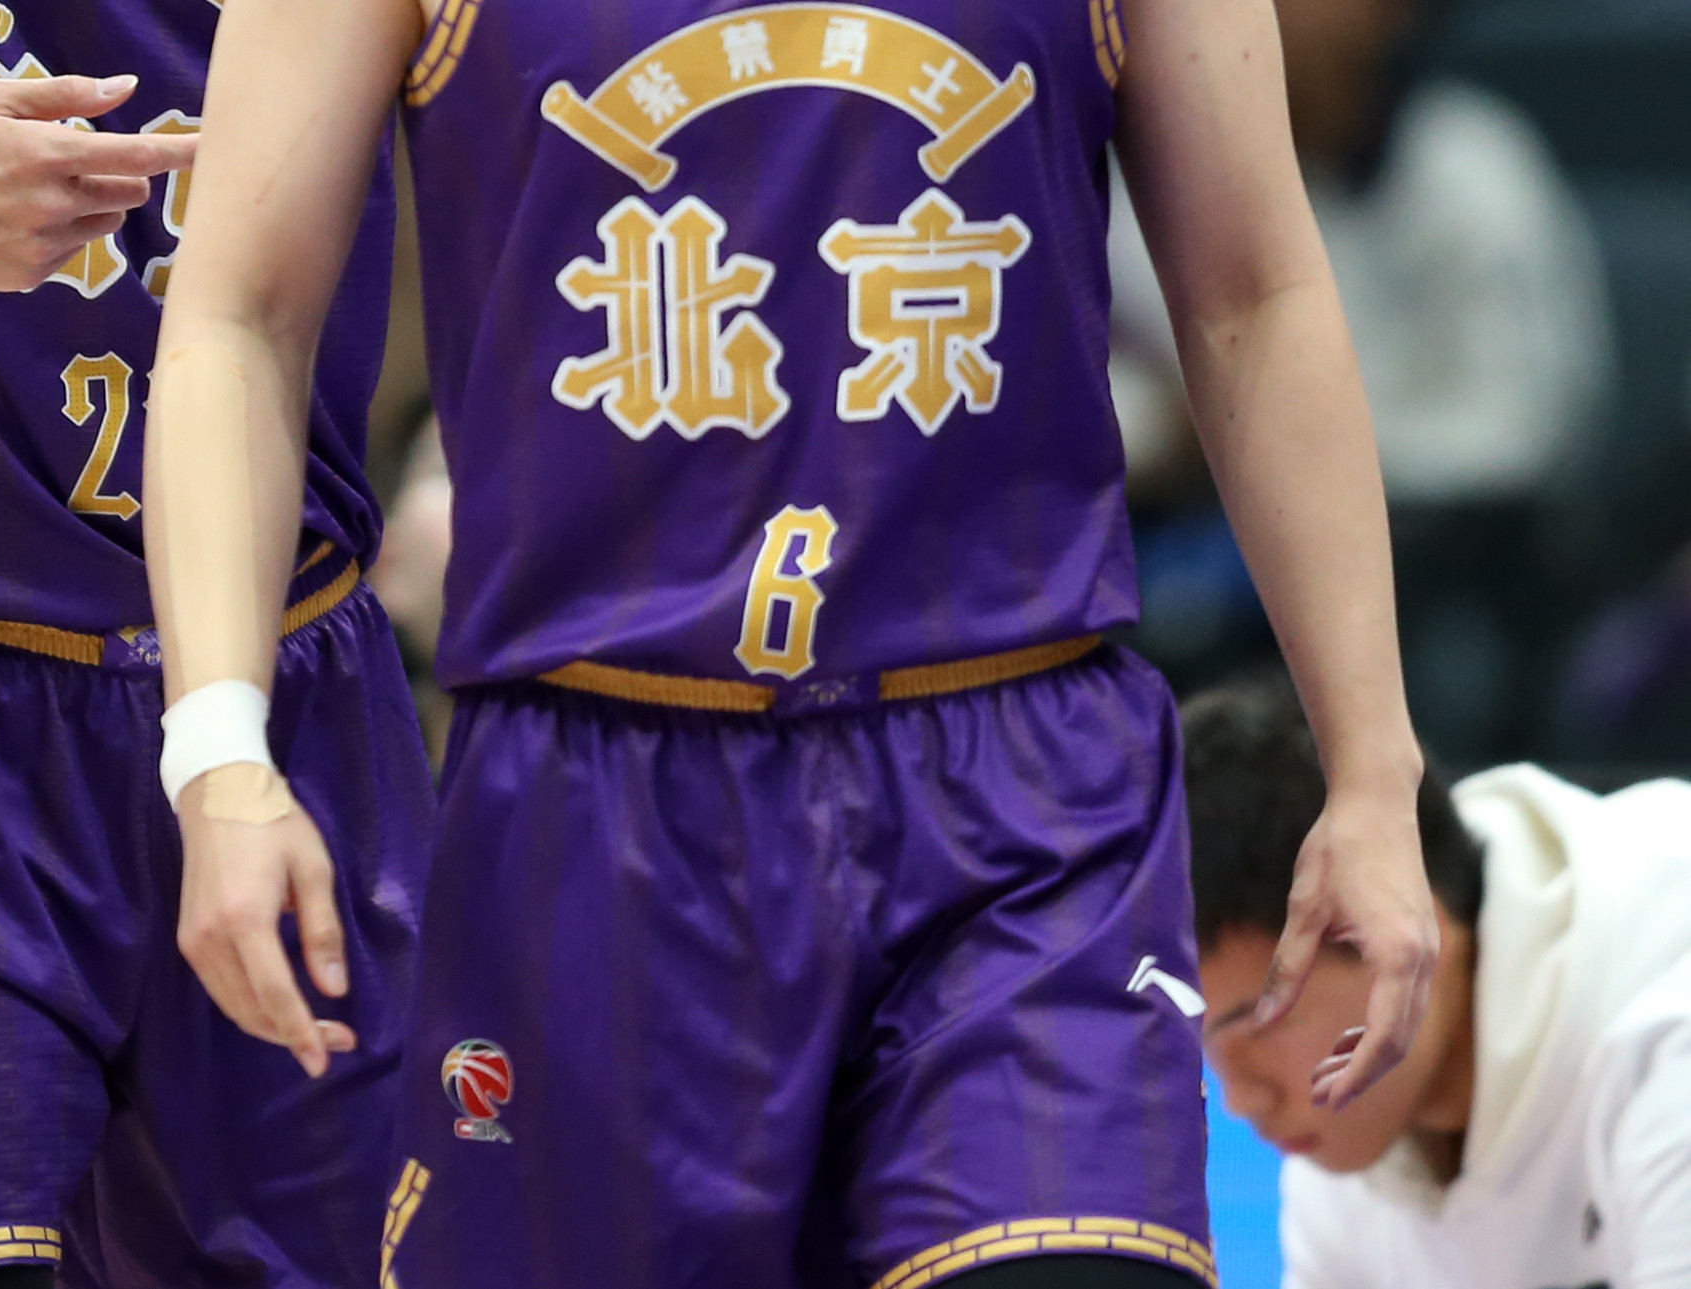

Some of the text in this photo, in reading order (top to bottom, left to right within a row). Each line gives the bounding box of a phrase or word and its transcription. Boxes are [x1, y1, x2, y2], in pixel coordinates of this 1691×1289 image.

[626, 15, 963, 127] 紫禁勇士
[552, 188, 1032, 440] 北京
[60, 351, 154, 521] 2
[733, 503, 839, 680] 6
